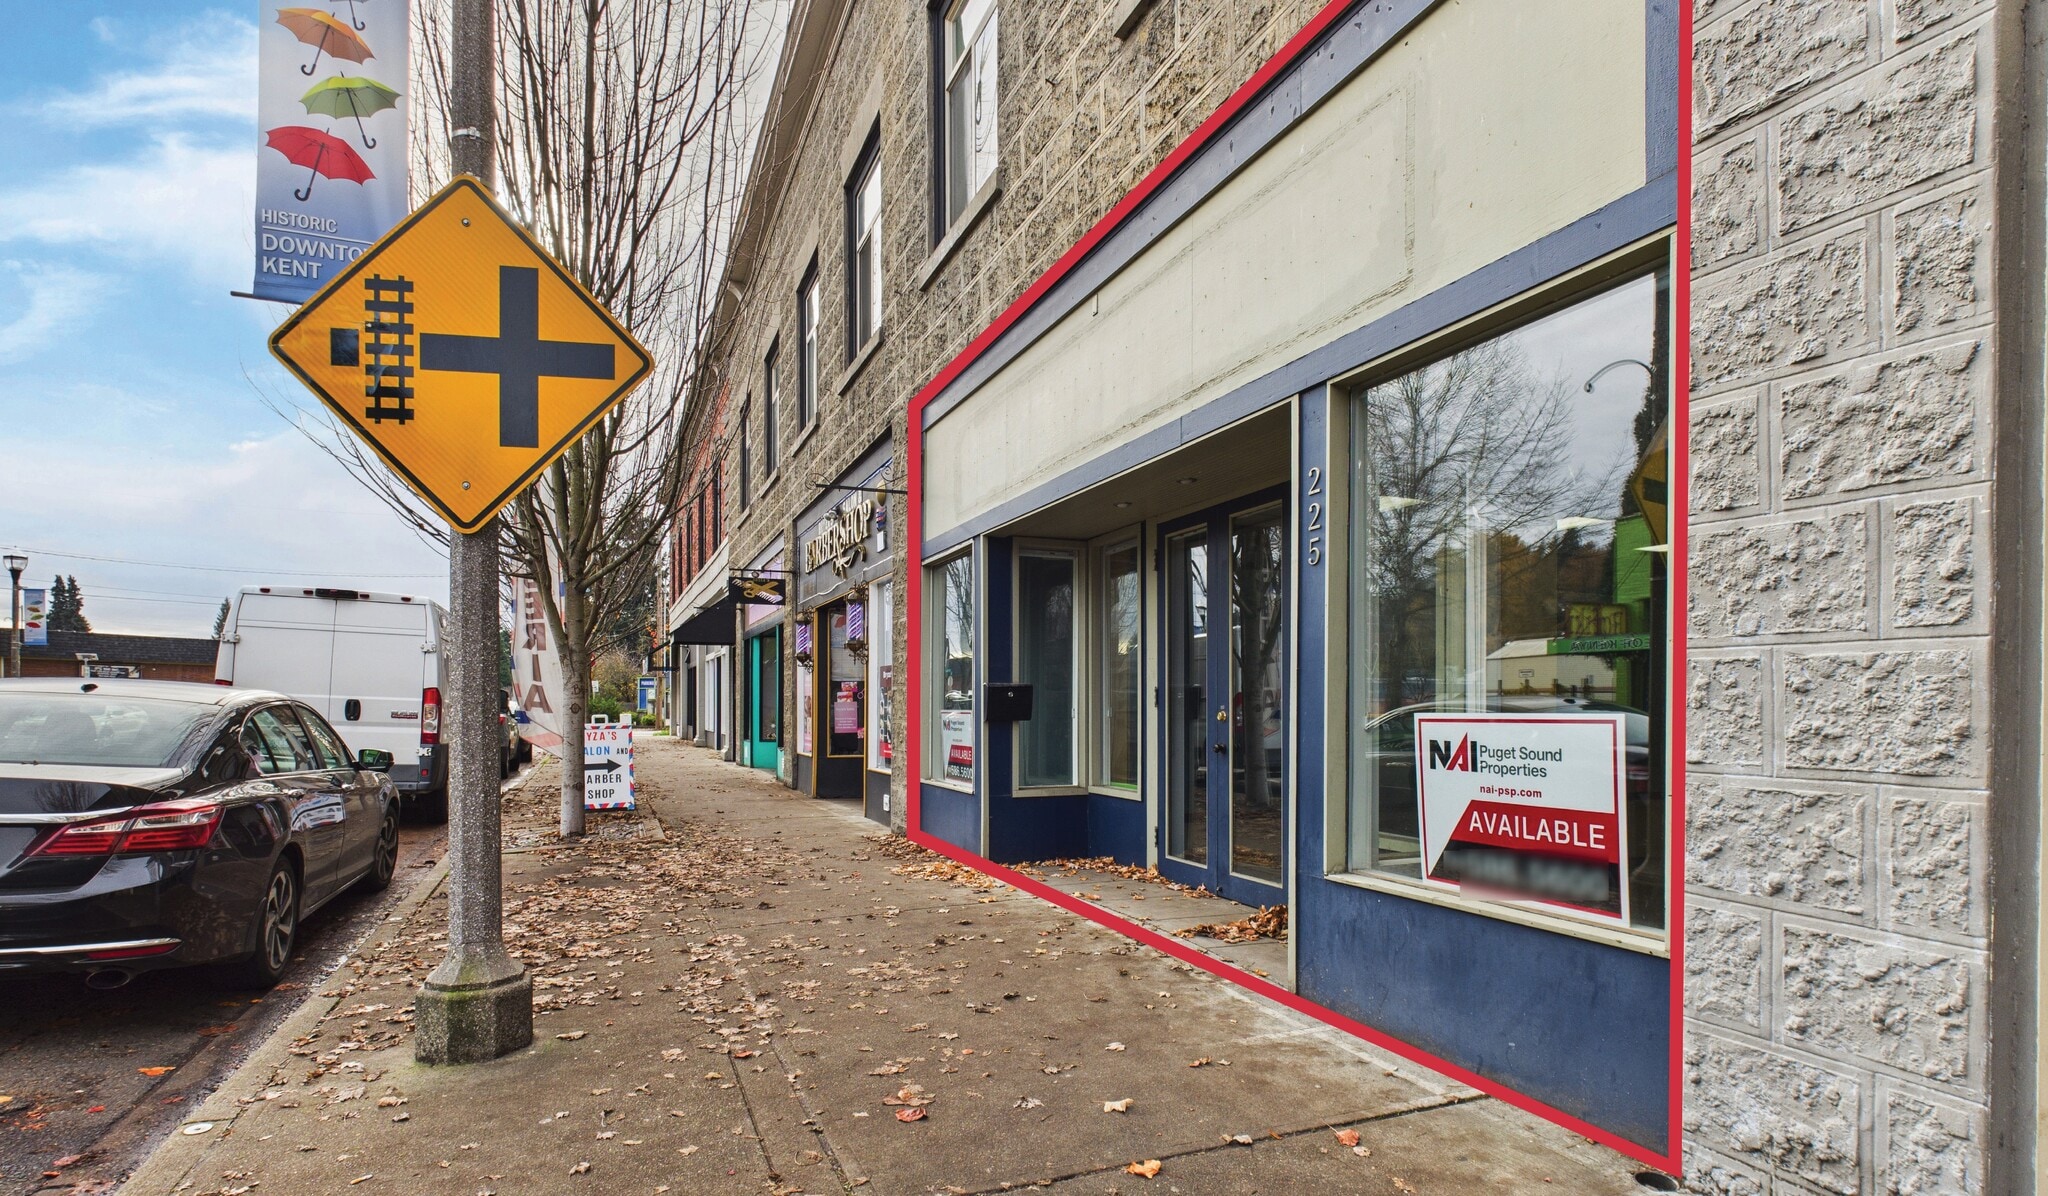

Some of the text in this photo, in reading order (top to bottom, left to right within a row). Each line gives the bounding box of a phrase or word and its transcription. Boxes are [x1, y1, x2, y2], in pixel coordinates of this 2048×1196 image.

[262, 208, 337, 233] HISTORIC
[262, 233, 371, 263] DOWNTO
[262, 256, 322, 279] KENT
[1308, 467, 1321, 565] 225
[804, 499, 872, 573] BARBERSHOP
[586, 731, 617, 741] YZA'S
[584, 746, 610, 755] ALON
[1429, 732, 1478, 772] NAI
[1480, 745, 1562, 762] Puget Sound
[586, 773, 622, 784] ARBER
[1480, 760, 1547, 778] Properties
[587, 789, 615, 799] SHOP
[1480, 785, 1542, 798] nai-psp.com
[1469, 811, 1606, 849] AVAILABLE
